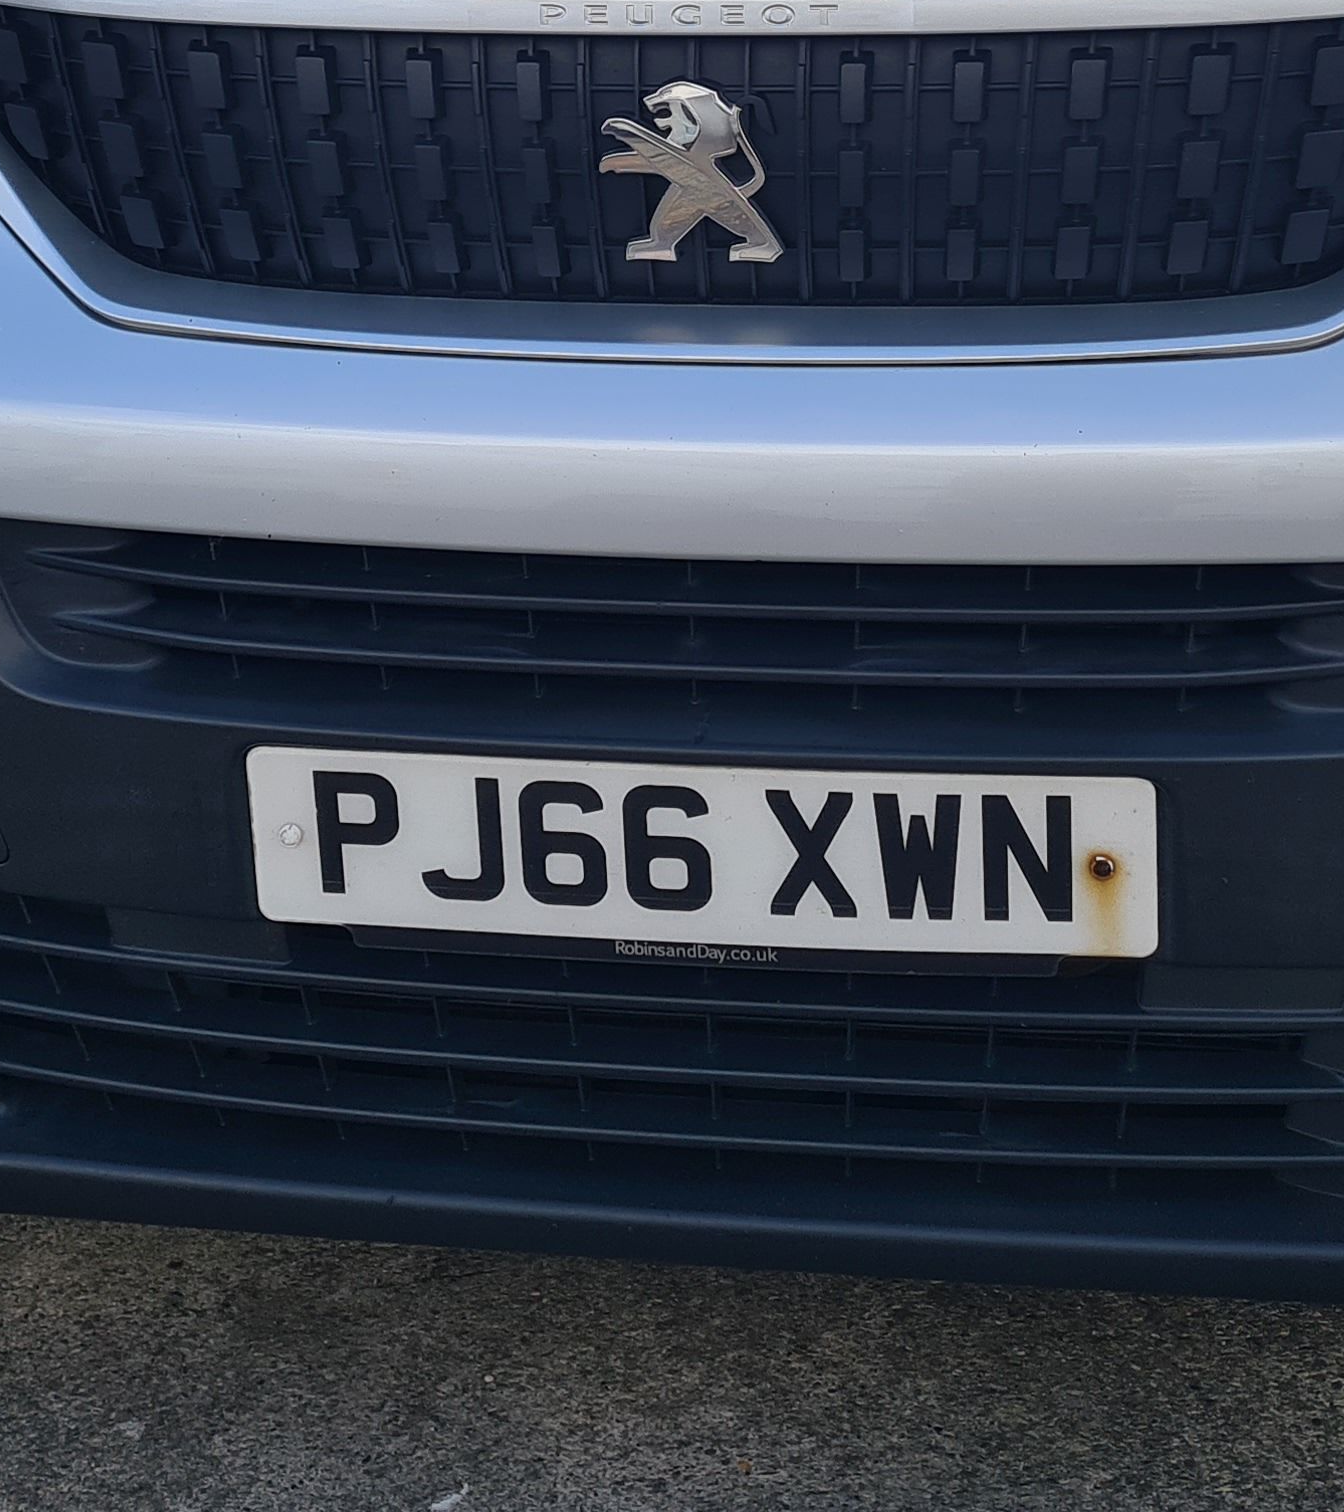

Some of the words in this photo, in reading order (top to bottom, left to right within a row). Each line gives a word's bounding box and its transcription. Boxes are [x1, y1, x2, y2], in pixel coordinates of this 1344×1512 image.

[539, 2, 840, 26] PEUGEOT
[311, 769, 715, 913] PJ66
[763, 789, 1074, 923] XWN
[615, 940, 779, 965] RobinsandDay.co.uk
